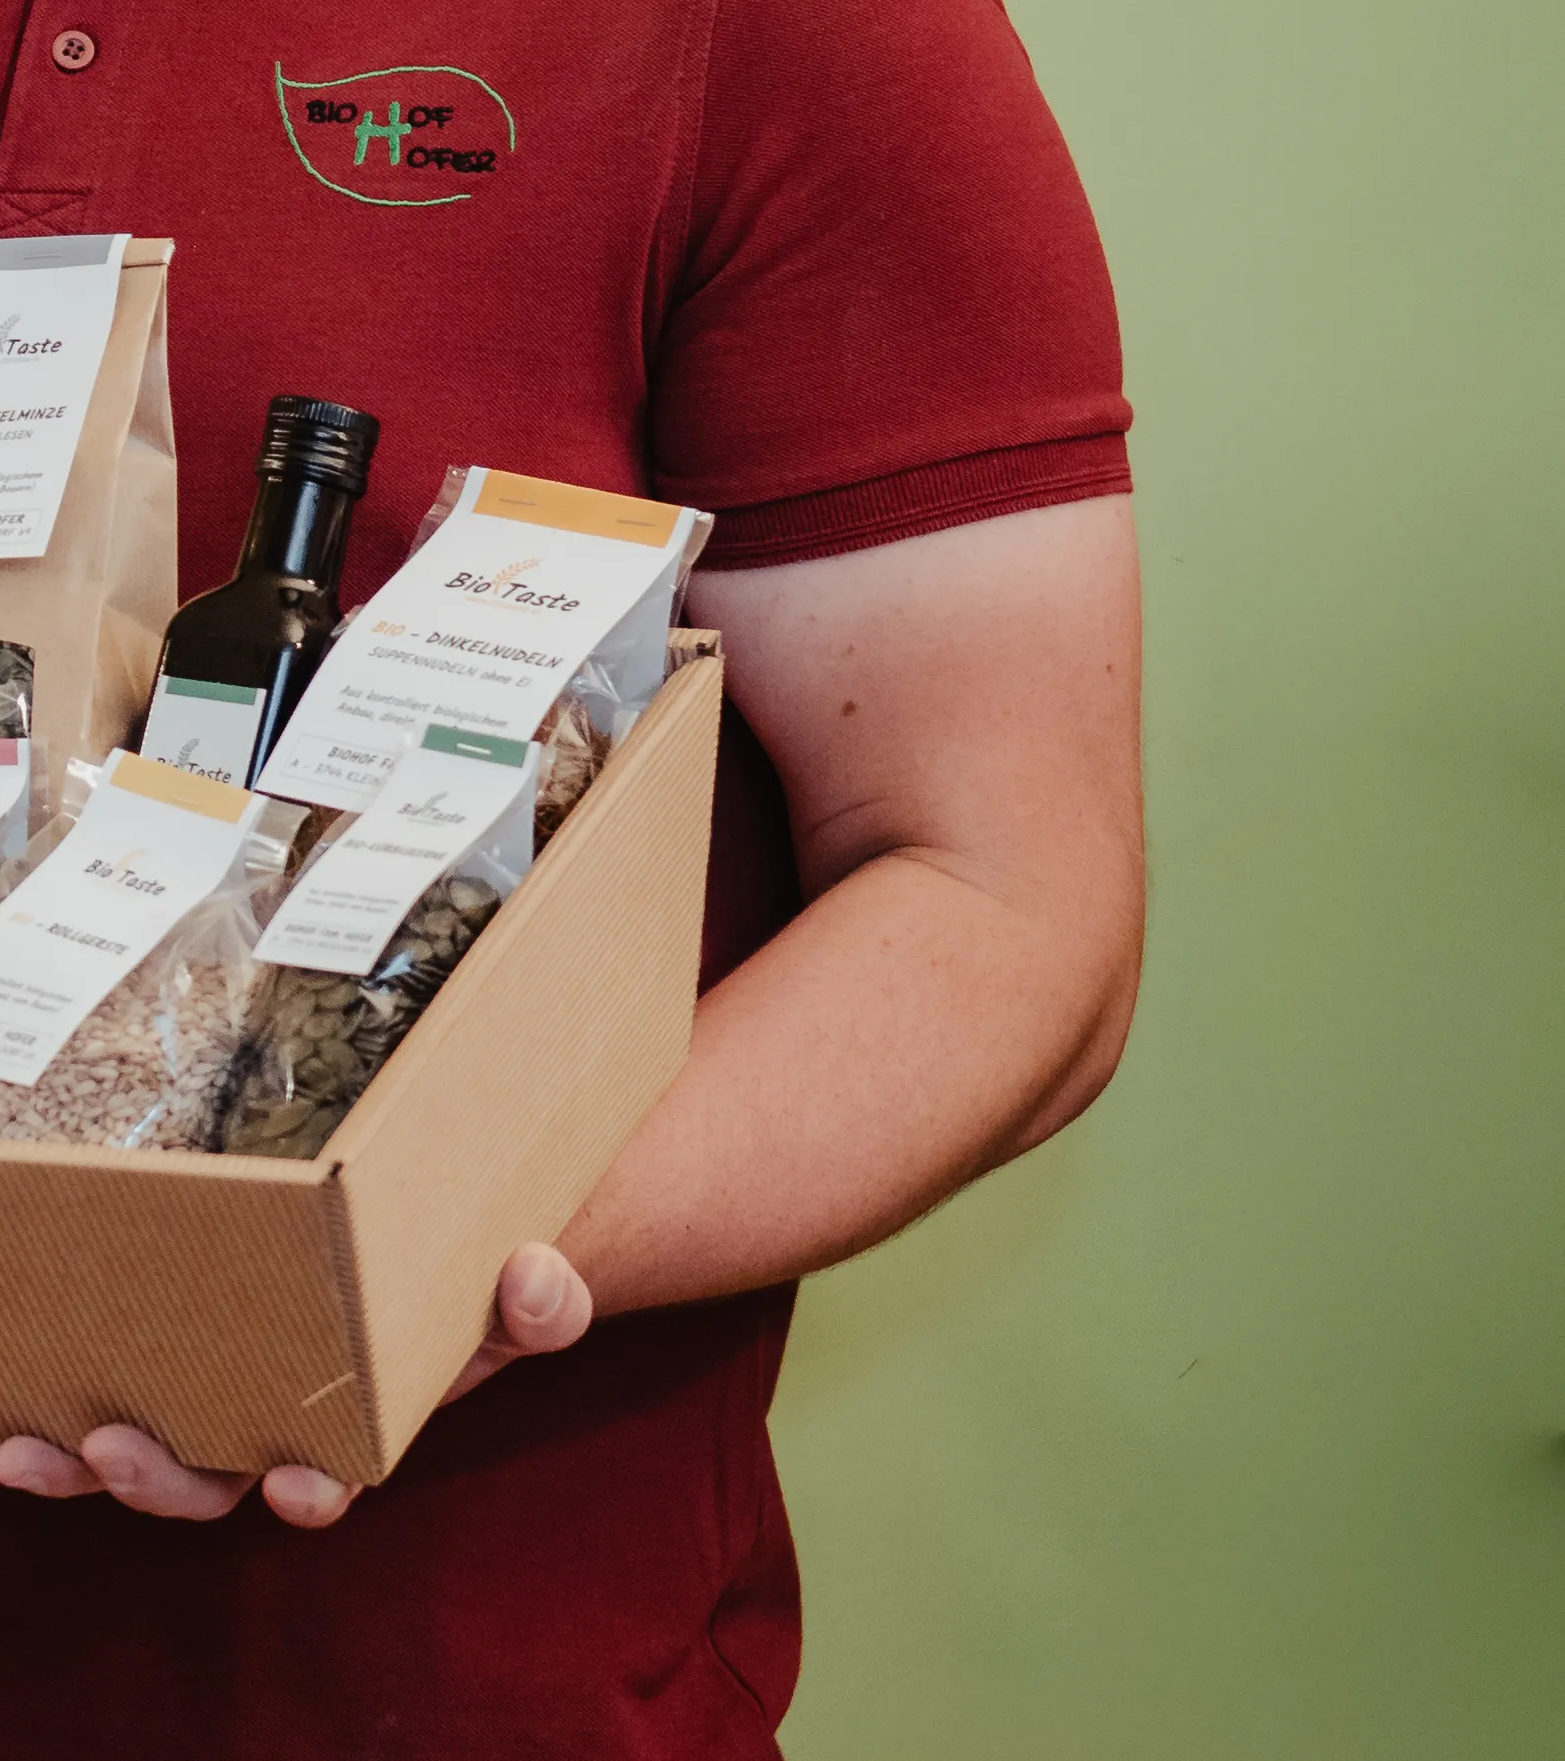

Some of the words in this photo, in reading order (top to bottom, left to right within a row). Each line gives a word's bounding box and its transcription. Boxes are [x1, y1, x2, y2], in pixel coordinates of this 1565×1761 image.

[306, 99, 358, 124] BIO
[5, 338, 64, 357] Taste
[444, 572, 492, 595] Bio
[501, 580, 582, 613] Taste
[371, 620, 406, 637] BIO
[425, 630, 564, 670] DINKELNUDELN
[368, 645, 479, 678] SUPPENNUDELN
[481, 670, 513, 685] ohne
[327, 746, 377, 765] BIOHOF
[83, 859, 113, 880] Bio
[118, 868, 167, 898] Taste
